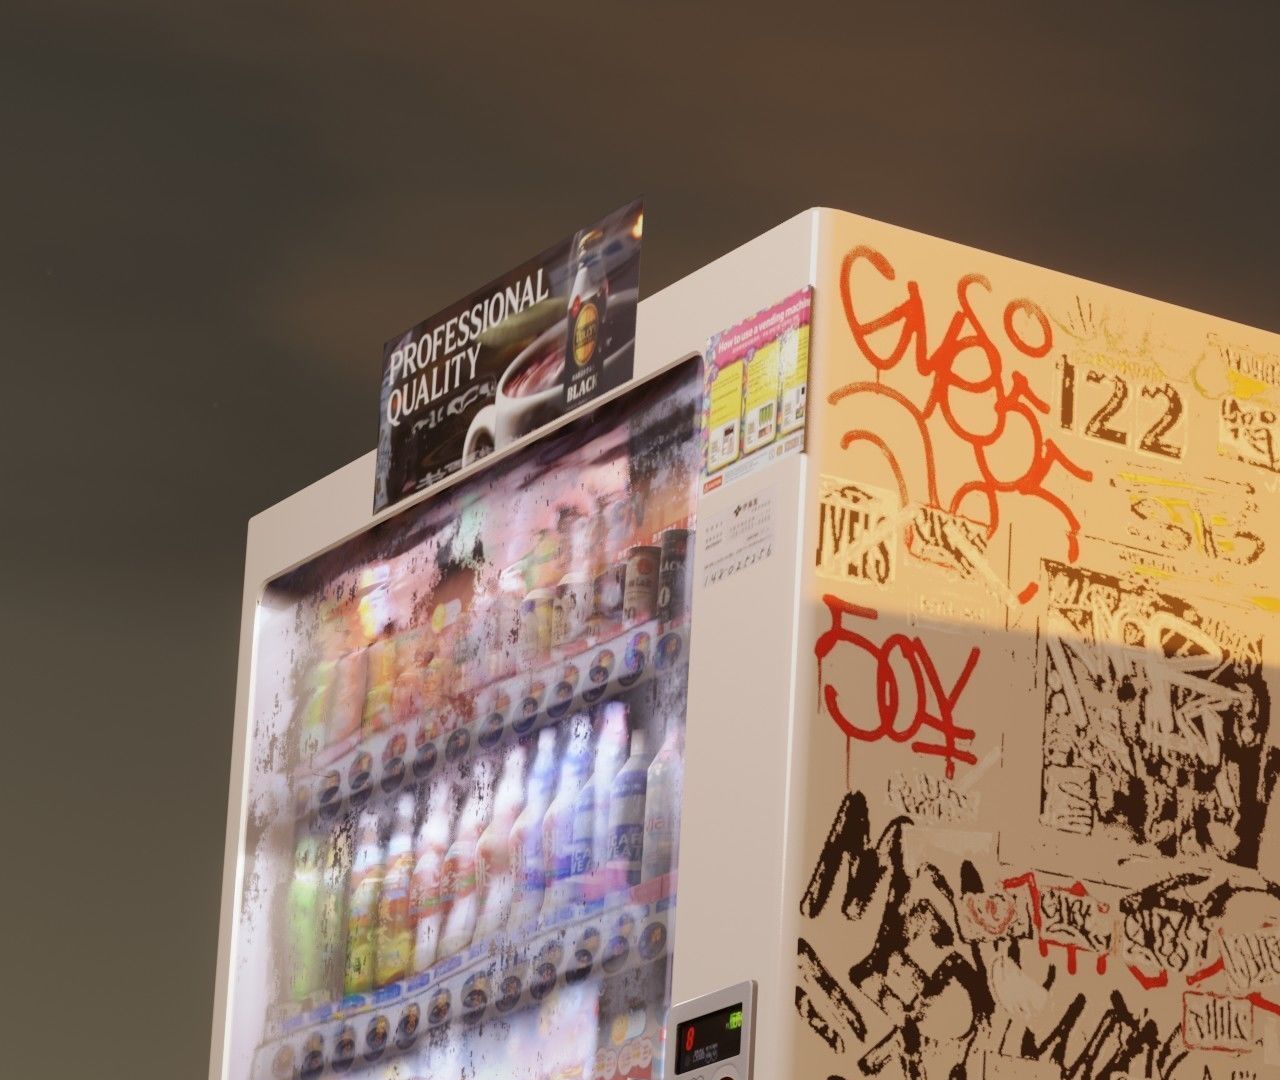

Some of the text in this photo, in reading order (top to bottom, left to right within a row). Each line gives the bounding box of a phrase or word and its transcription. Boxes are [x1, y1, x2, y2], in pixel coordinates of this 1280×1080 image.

[388, 268, 549, 386] PROFESSIONAL
[718, 339, 734, 354] How
[386, 342, 482, 427] QUALITY
[567, 374, 598, 403] BLACK
[1058, 354, 1183, 459] 122
[685, 1025, 696, 1051] 8
